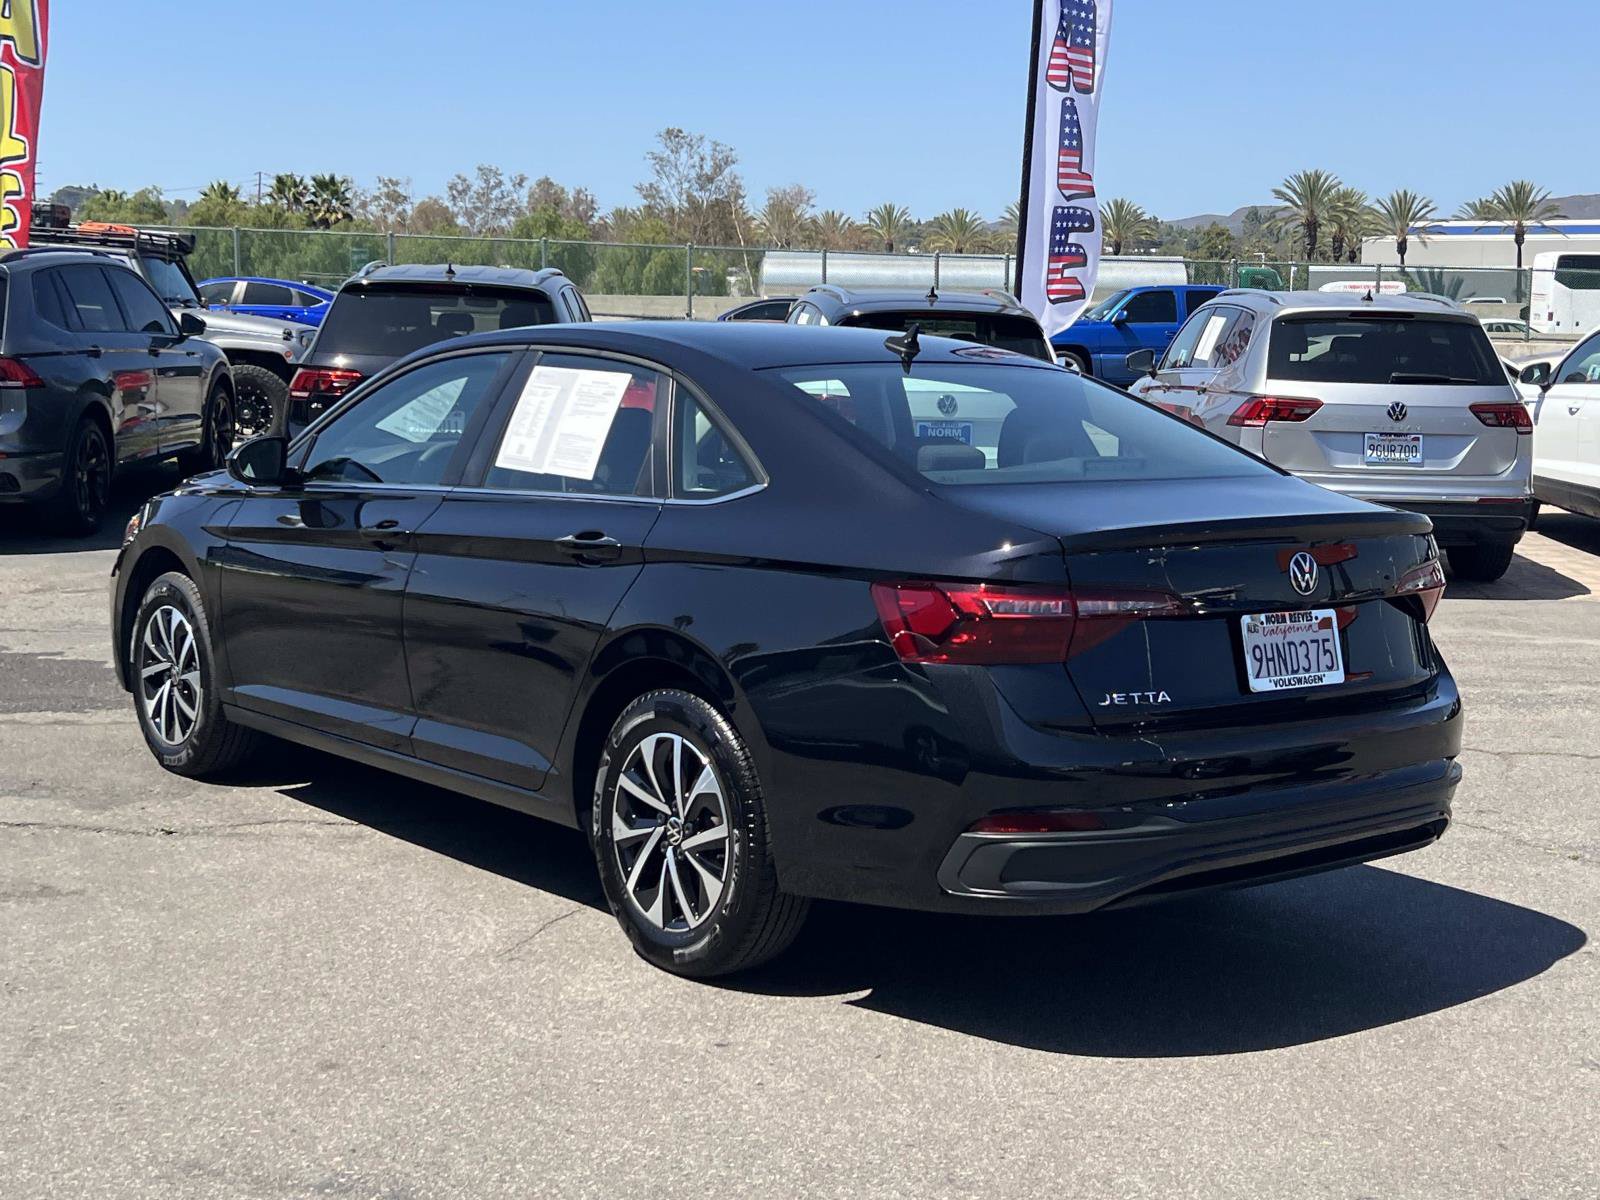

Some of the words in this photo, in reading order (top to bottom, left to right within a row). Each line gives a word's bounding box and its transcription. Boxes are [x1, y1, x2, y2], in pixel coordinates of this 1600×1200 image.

[927, 428, 962, 437] NORM
[1368, 443, 1418, 458] 9GUR700
[1264, 613, 1287, 626] NORM
[1289, 611, 1313, 623] REEVES
[1262, 624, 1318, 640] California
[1251, 638, 1335, 679] 9HND375
[1098, 690, 1172, 706] JETTA
